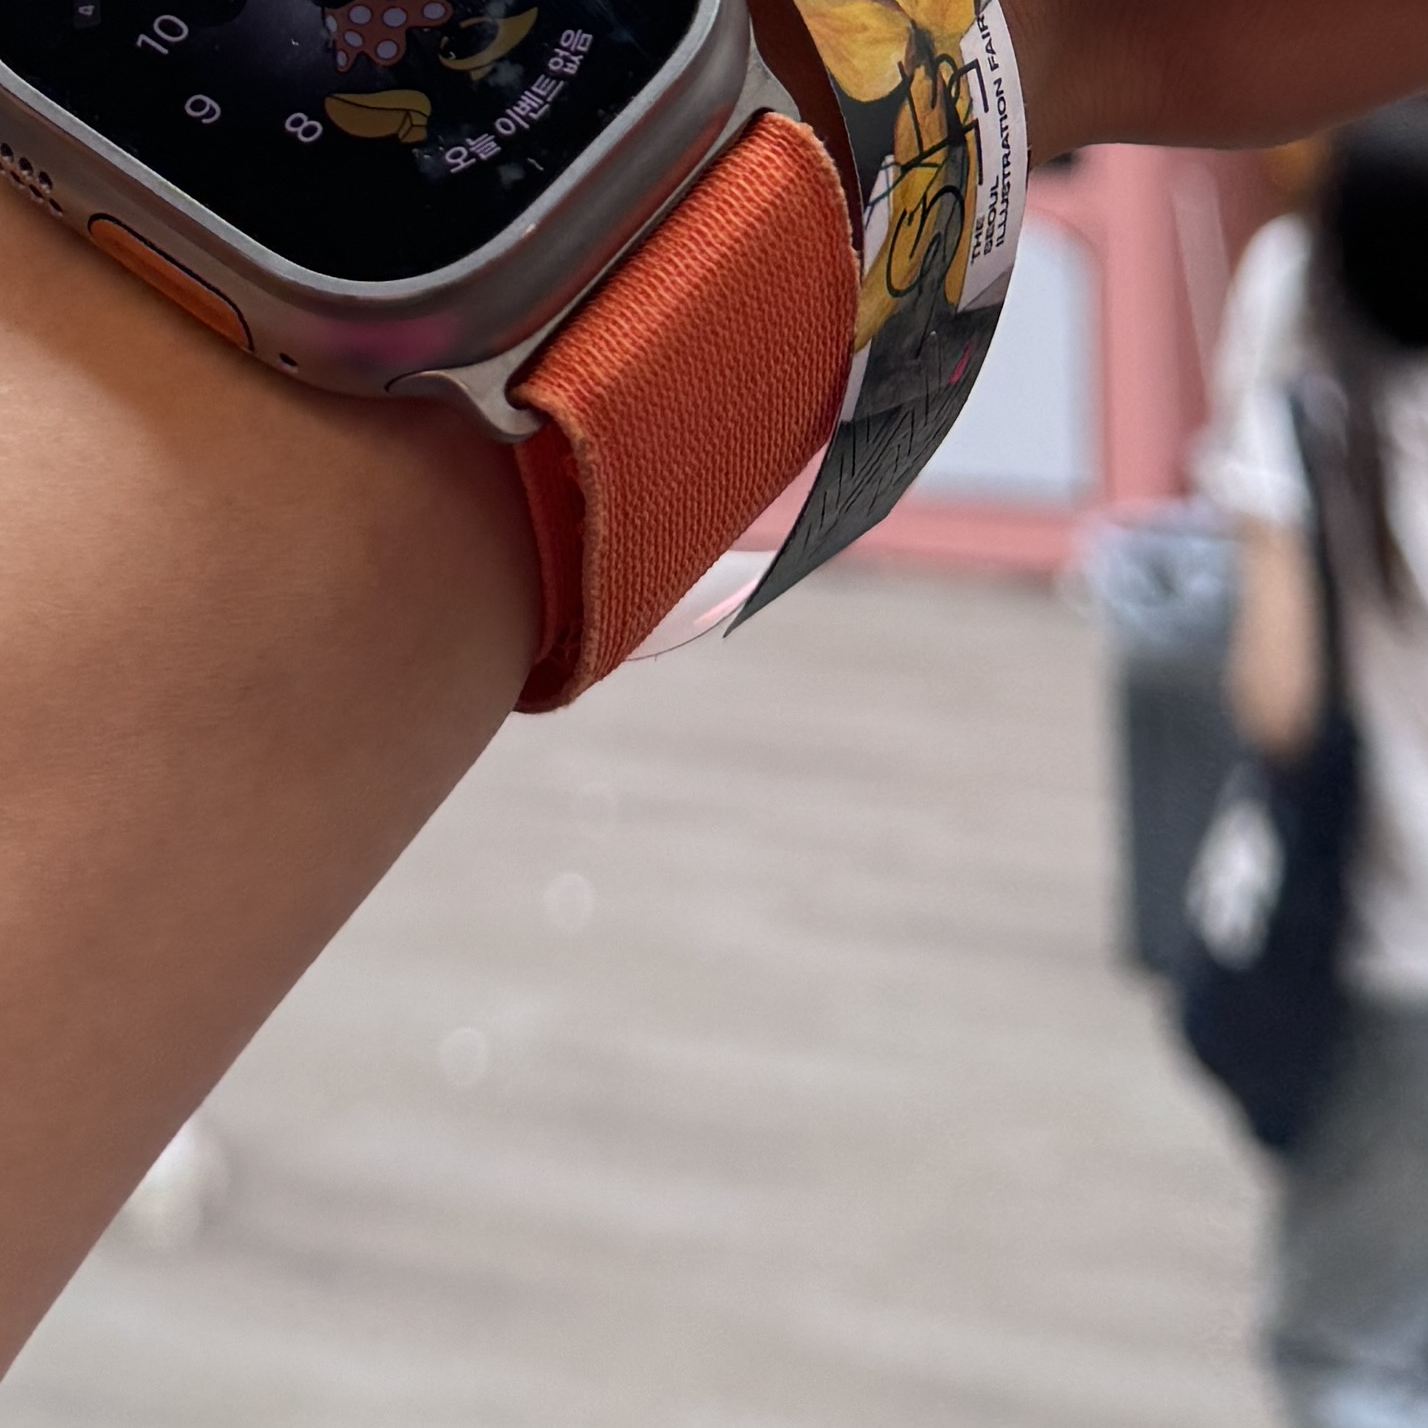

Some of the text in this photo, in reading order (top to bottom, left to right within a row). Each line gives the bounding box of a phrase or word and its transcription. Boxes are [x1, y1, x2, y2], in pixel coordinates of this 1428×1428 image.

[135, 13, 190, 55] 10
[184, 93, 223, 126] 9
[284, 111, 324, 143] 8
[444, 28, 595, 175] 오늘 이벤트 없음
[976, 13, 1012, 248] ILLUSTRATION FAIR
[970, 212, 986, 265] THE
[983, 174, 1001, 256] SEOUL
